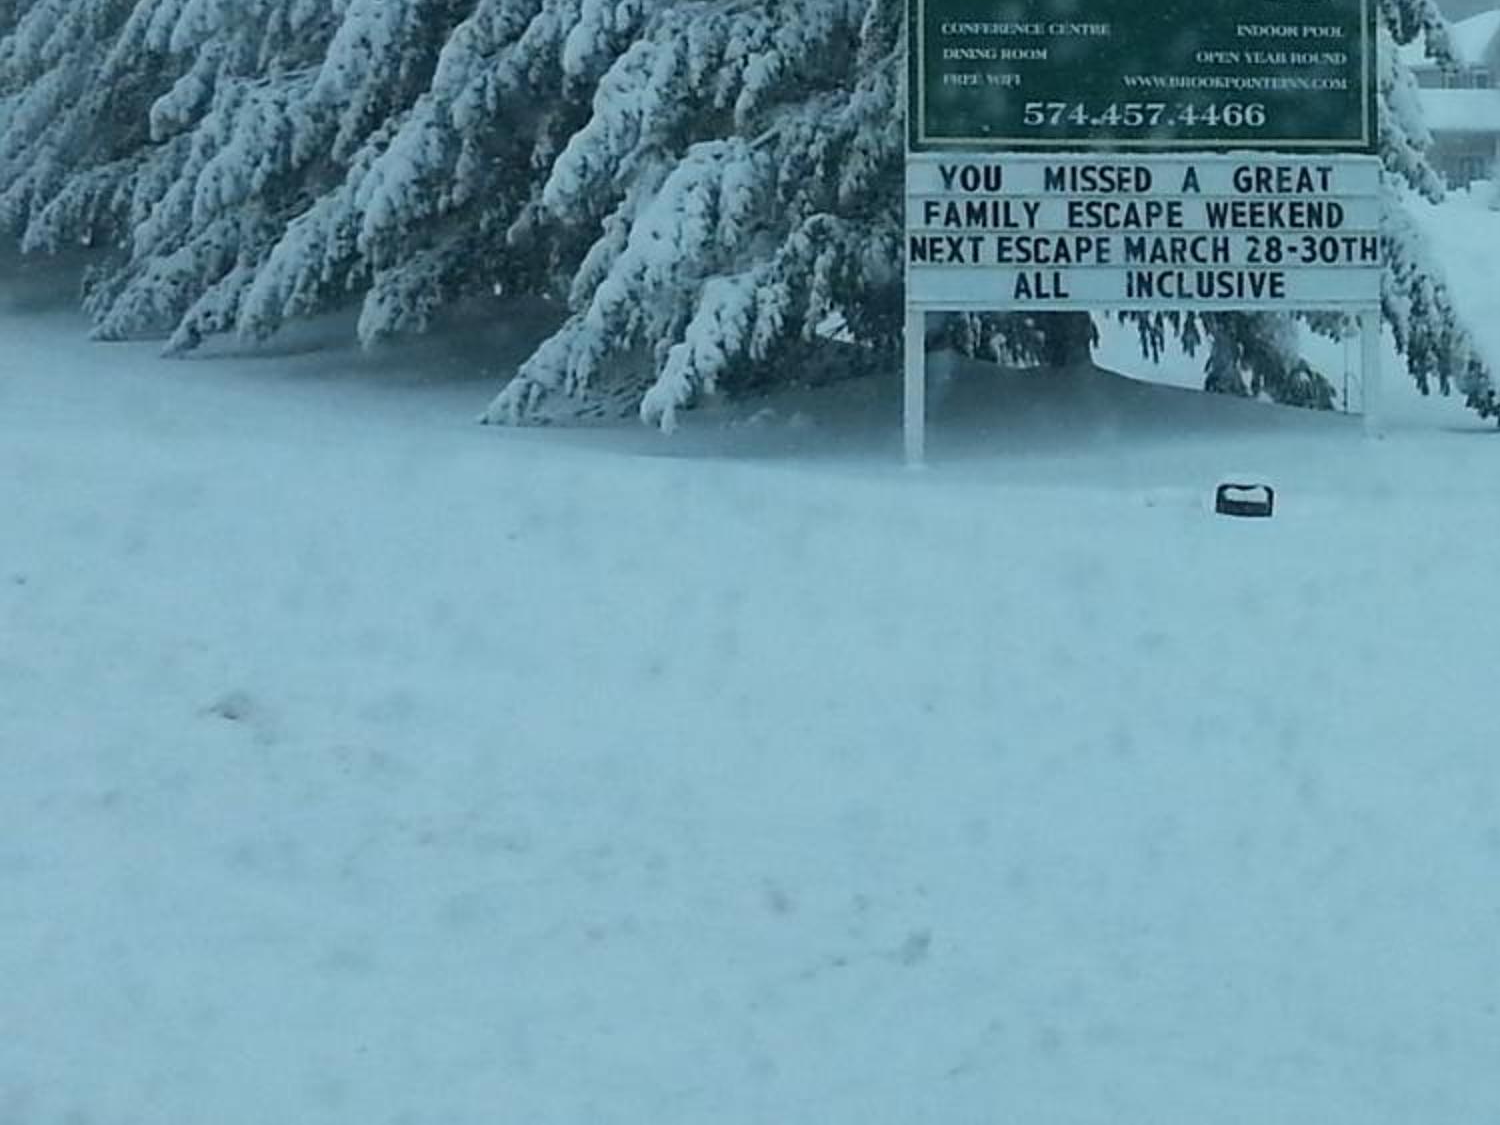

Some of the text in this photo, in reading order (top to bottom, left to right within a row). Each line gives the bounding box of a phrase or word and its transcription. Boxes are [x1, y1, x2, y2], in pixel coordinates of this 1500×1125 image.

[1237, 24, 1344, 38] INDOOR POOL
[943, 47, 1048, 61] DINING ROOM
[1196, 51, 1240, 65] OPEN
[1290, 52, 1347, 65] ROUND
[1023, 102, 1266, 127] 574.457.4466
[939, 165, 1333, 194] YOU MISSED A GREAT
[924, 201, 1344, 229] FAMILY ESCAPE WEEKEND
[910, 236, 1378, 264] NEXT ESCAPE MARCH 28-30TH
[1014, 272, 1286, 299] ALL INCLUSIVE
